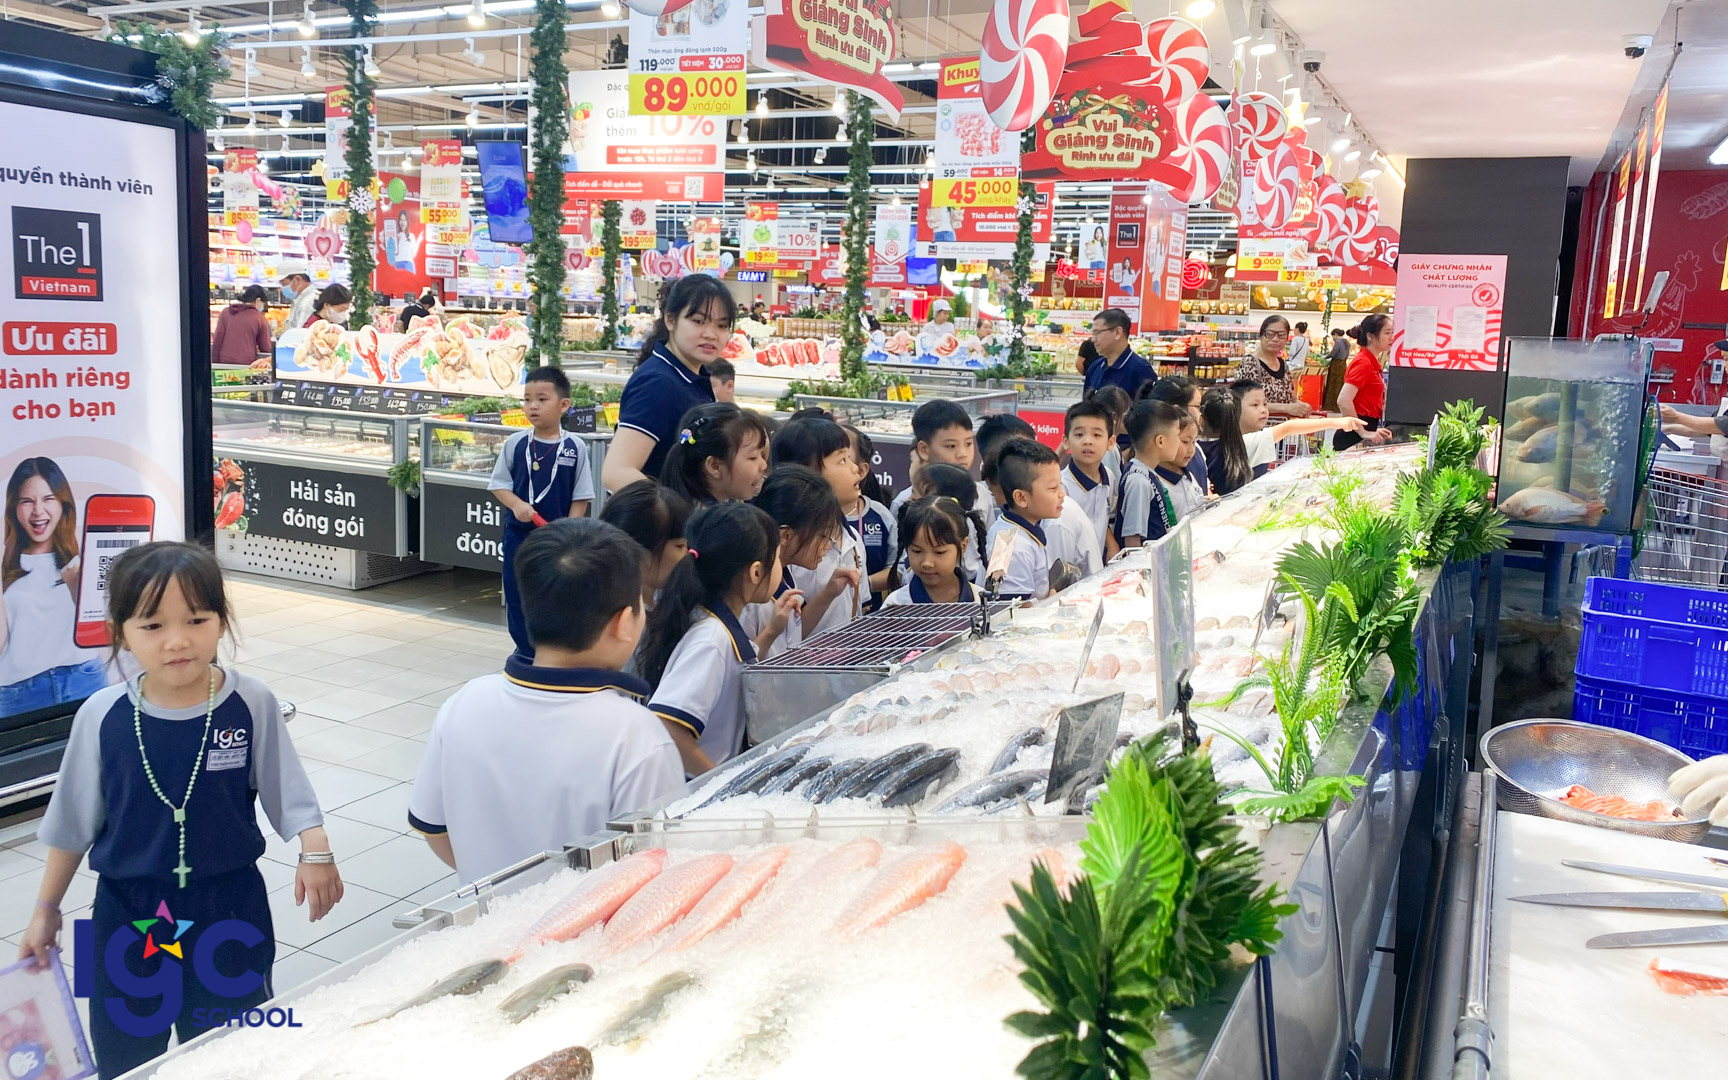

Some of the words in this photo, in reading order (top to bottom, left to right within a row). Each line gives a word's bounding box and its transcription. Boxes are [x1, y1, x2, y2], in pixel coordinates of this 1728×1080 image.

[838, 0, 858, 12] ui
[800, 0, 850, 36] Giáng
[853, 14, 888, 54] Sinh
[712, 46, 727, 54] 500g
[816, 28, 838, 51] Rinh
[855, 46, 870, 62] đãi
[639, 58, 675, 72] 119.000
[708, 56, 742, 70] 30.000
[643, 76, 738, 112] 89.000
[692, 100, 731, 112] vnd/gói
[606, 125, 637, 136] thêm
[1092, 120, 1118, 132] Vui
[1053, 132, 1108, 150] Giáng
[1112, 132, 1154, 152] Sinh
[1071, 151, 1096, 161] Rinh
[1098, 153, 1114, 162] ưu
[1116, 152, 1134, 162] đãi
[59, 171, 112, 190] thành
[118, 178, 152, 195] viên
[948, 181, 1012, 204] 45.000
[1127, 204, 1146, 212] quyền
[428, 210, 458, 222] 55.000
[440, 233, 466, 242] 130.000
[788, 233, 816, 246] 10%
[1120, 230, 1132, 238] The
[19, 235, 76, 265] The
[77, 222, 90, 266] 1
[1253, 258, 1281, 268] 9.000
[1411, 262, 1430, 270] GIẤY
[1433, 262, 1464, 270] CHỨNG
[1466, 263, 1492, 272] NHẬN
[737, 272, 766, 282] EMMY
[1422, 272, 1445, 280] CHẤT
[1448, 274, 1478, 282] LƯỢNG
[29, 280, 90, 294] Vietnam
[11, 326, 54, 350] Ưu
[62, 328, 107, 350] đãi
[66, 367, 130, 390] riêng
[12, 400, 61, 420] cho
[69, 398, 116, 422] bạn
[1038, 424, 1059, 436] kiệm
[290, 479, 318, 502] Hải
[324, 482, 356, 508] sản
[466, 502, 500, 526] Hải
[282, 507, 329, 535] đóng
[334, 515, 364, 538] gói
